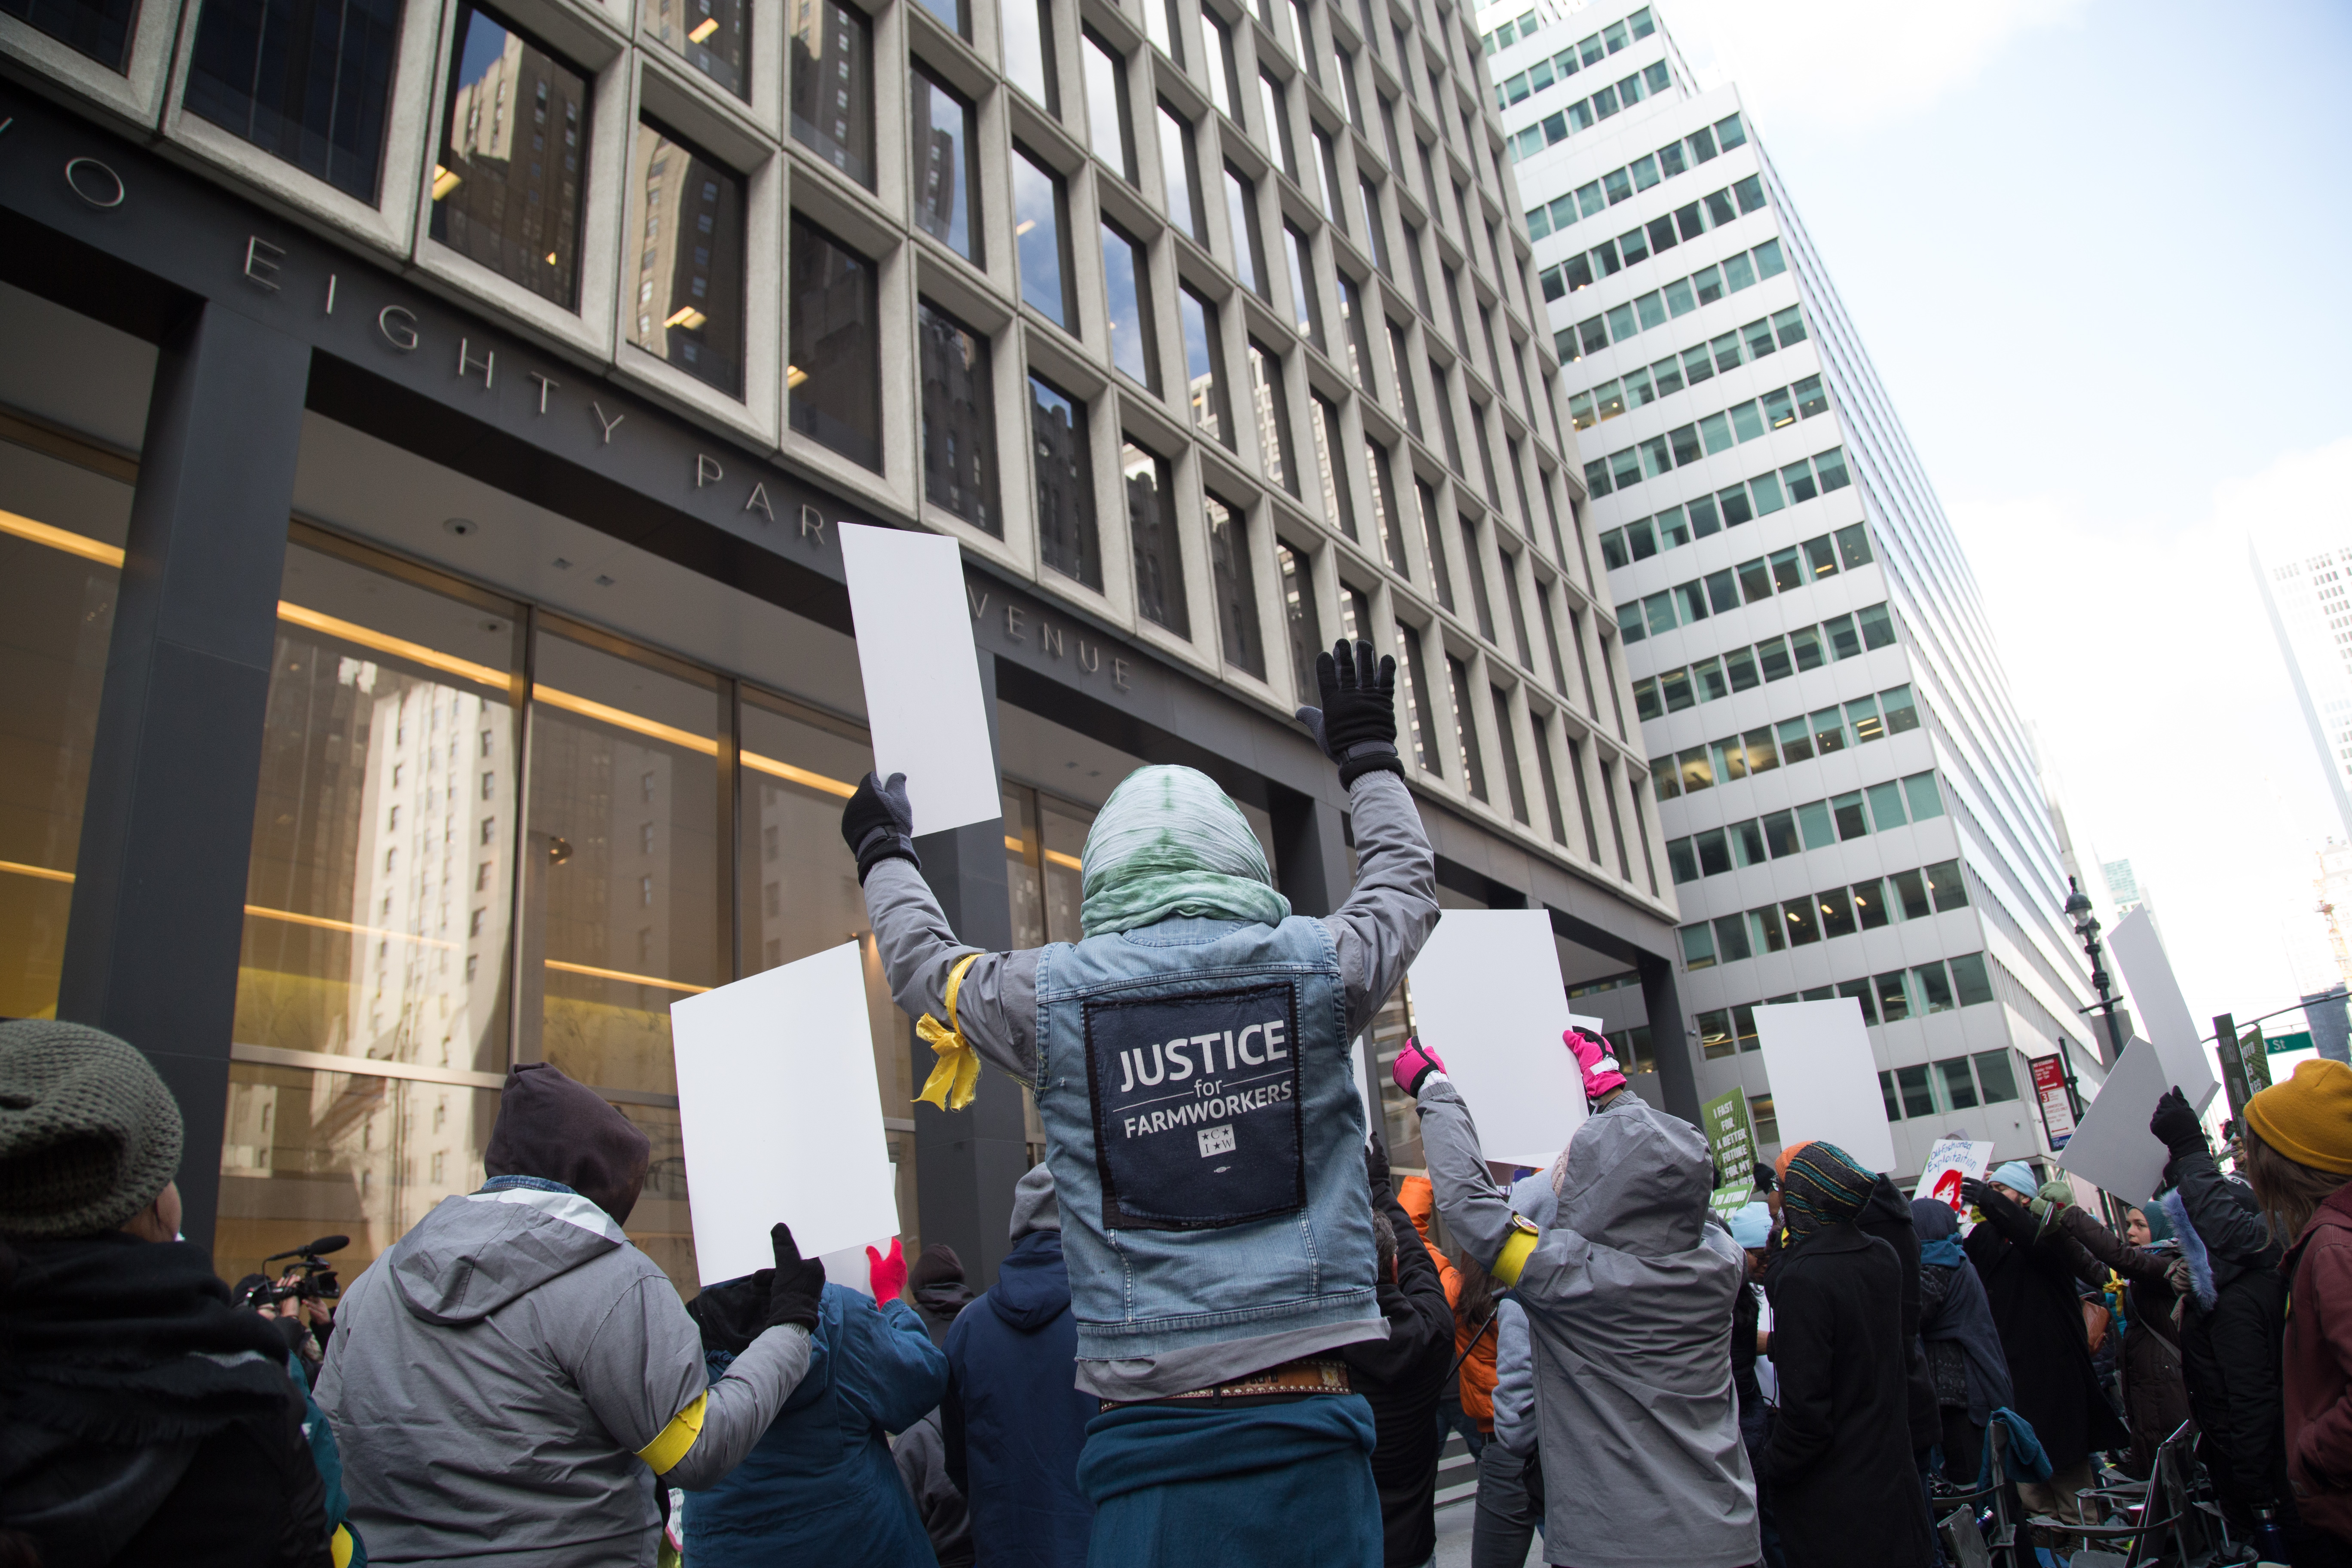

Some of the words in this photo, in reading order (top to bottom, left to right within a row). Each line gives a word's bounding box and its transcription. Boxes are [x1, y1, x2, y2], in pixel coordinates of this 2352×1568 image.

[0, 116, 125, 207] O
[245, 235, 624, 443] EIGHTY
[697, 453, 824, 545] PAR
[968, 585, 1131, 689] VENUE
[2241, 1041, 2255, 1059] OYO
[2272, 1039, 2286, 1051] St
[1119, 1020, 1288, 1093] JUSTICE
[1194, 1079, 1222, 1098] for
[2042, 1093, 2048, 1102] 3
[1124, 1080, 1292, 1138] FARMWORKERS
[1713, 1109, 1718, 1119] I
[1717, 1100, 1733, 1118] FAST
[1721, 1117, 1735, 1132] FOR
[1717, 1139, 1722, 1150] A
[1722, 1128, 1747, 1148] BETTER
[1722, 1144, 1748, 1164] FUTURE
[1724, 1164, 1739, 1179] FOR
[1739, 1159, 1750, 1173] MY
